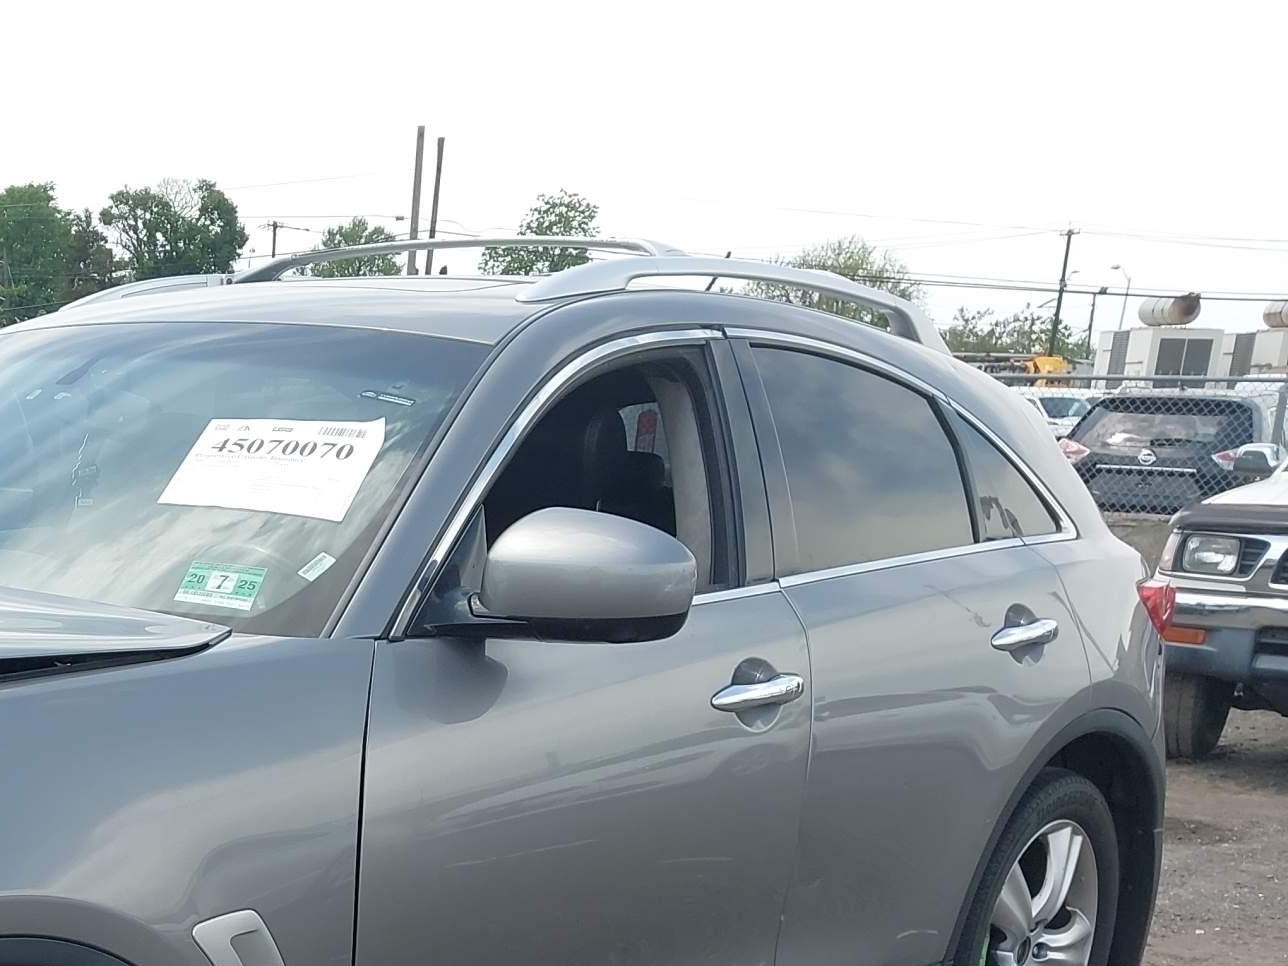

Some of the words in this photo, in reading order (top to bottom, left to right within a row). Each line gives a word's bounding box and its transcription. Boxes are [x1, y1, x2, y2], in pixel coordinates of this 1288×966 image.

[211, 437, 355, 461] 45070070
[187, 573, 206, 584] 20
[215, 574, 230, 590] 7
[238, 579, 257, 591] 25
